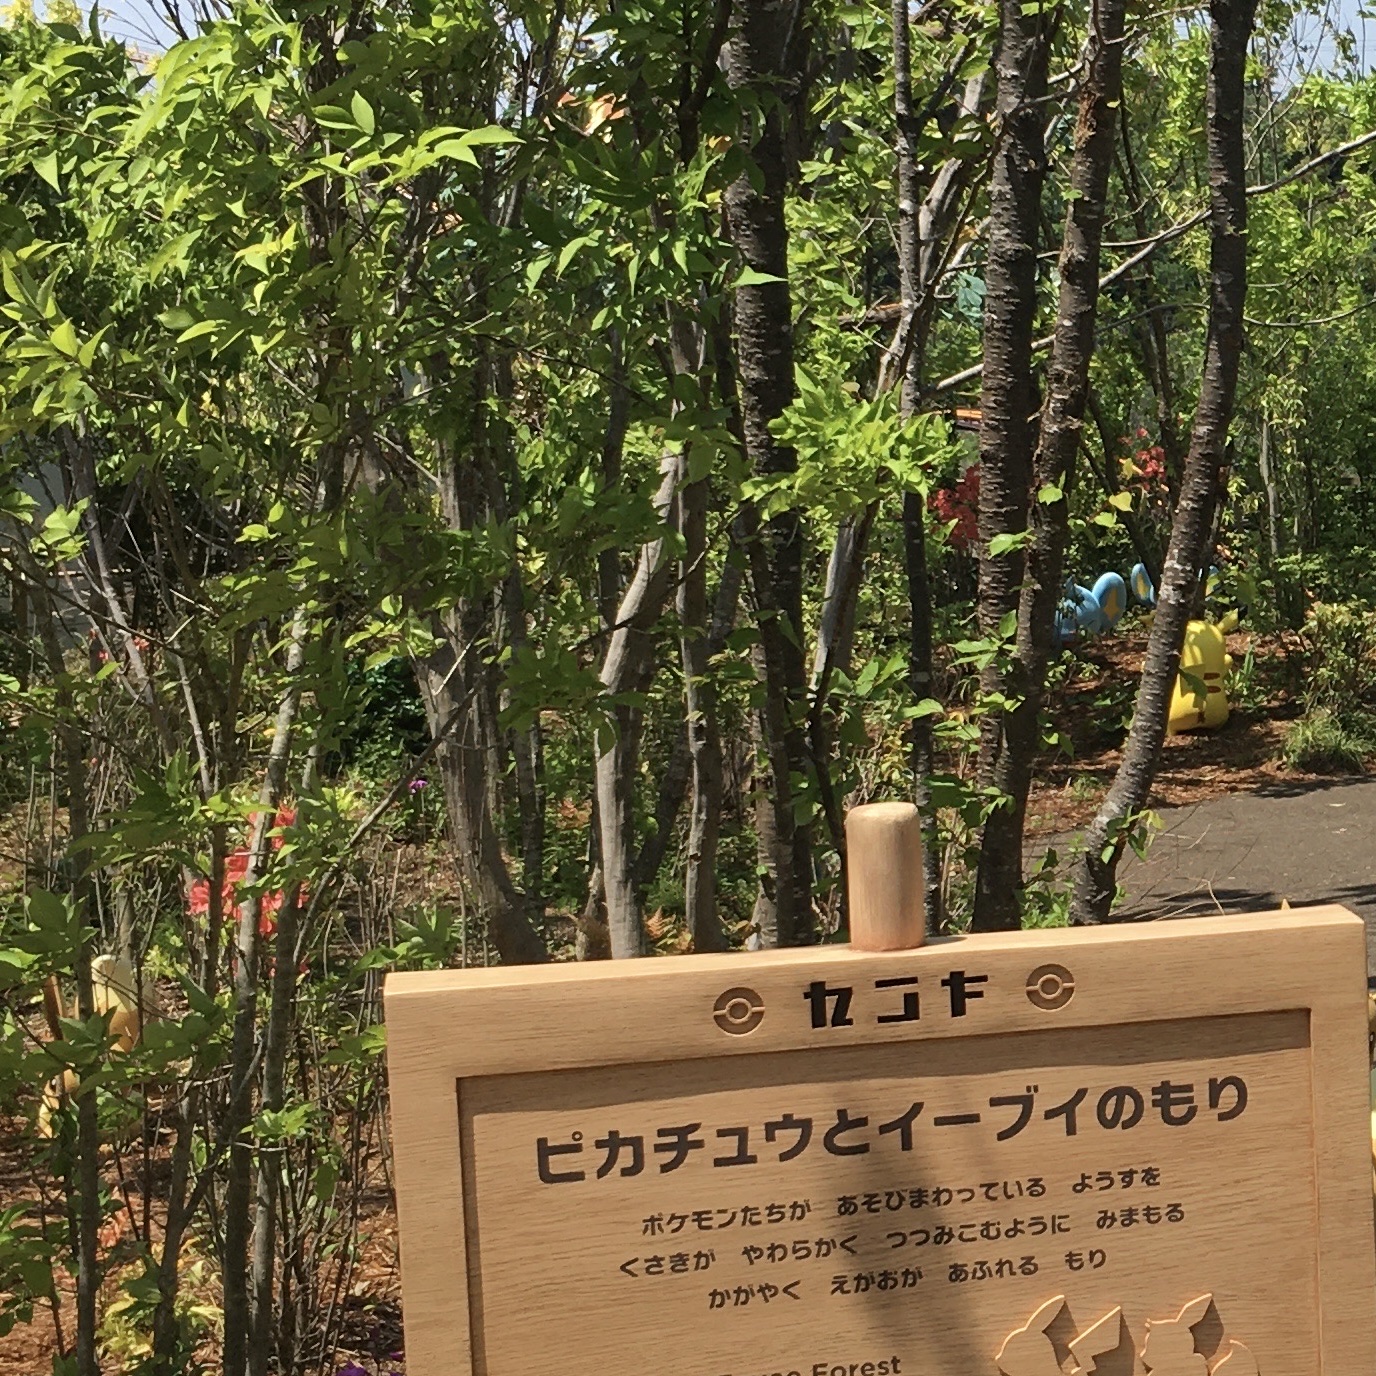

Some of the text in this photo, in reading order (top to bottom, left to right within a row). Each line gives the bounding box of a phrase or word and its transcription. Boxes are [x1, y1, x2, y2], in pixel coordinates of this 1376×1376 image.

[536, 1075, 1249, 1185] ピカチュウとイーブイのもり
[642, 1166, 1162, 1236] ポケモンたちが あそびまわっている ようすを
[619, 1203, 1185, 1278] くさきが やわらかく つつみこむように みまもる
[708, 1249, 1107, 1309] かがやく えがおが あふれる もり
